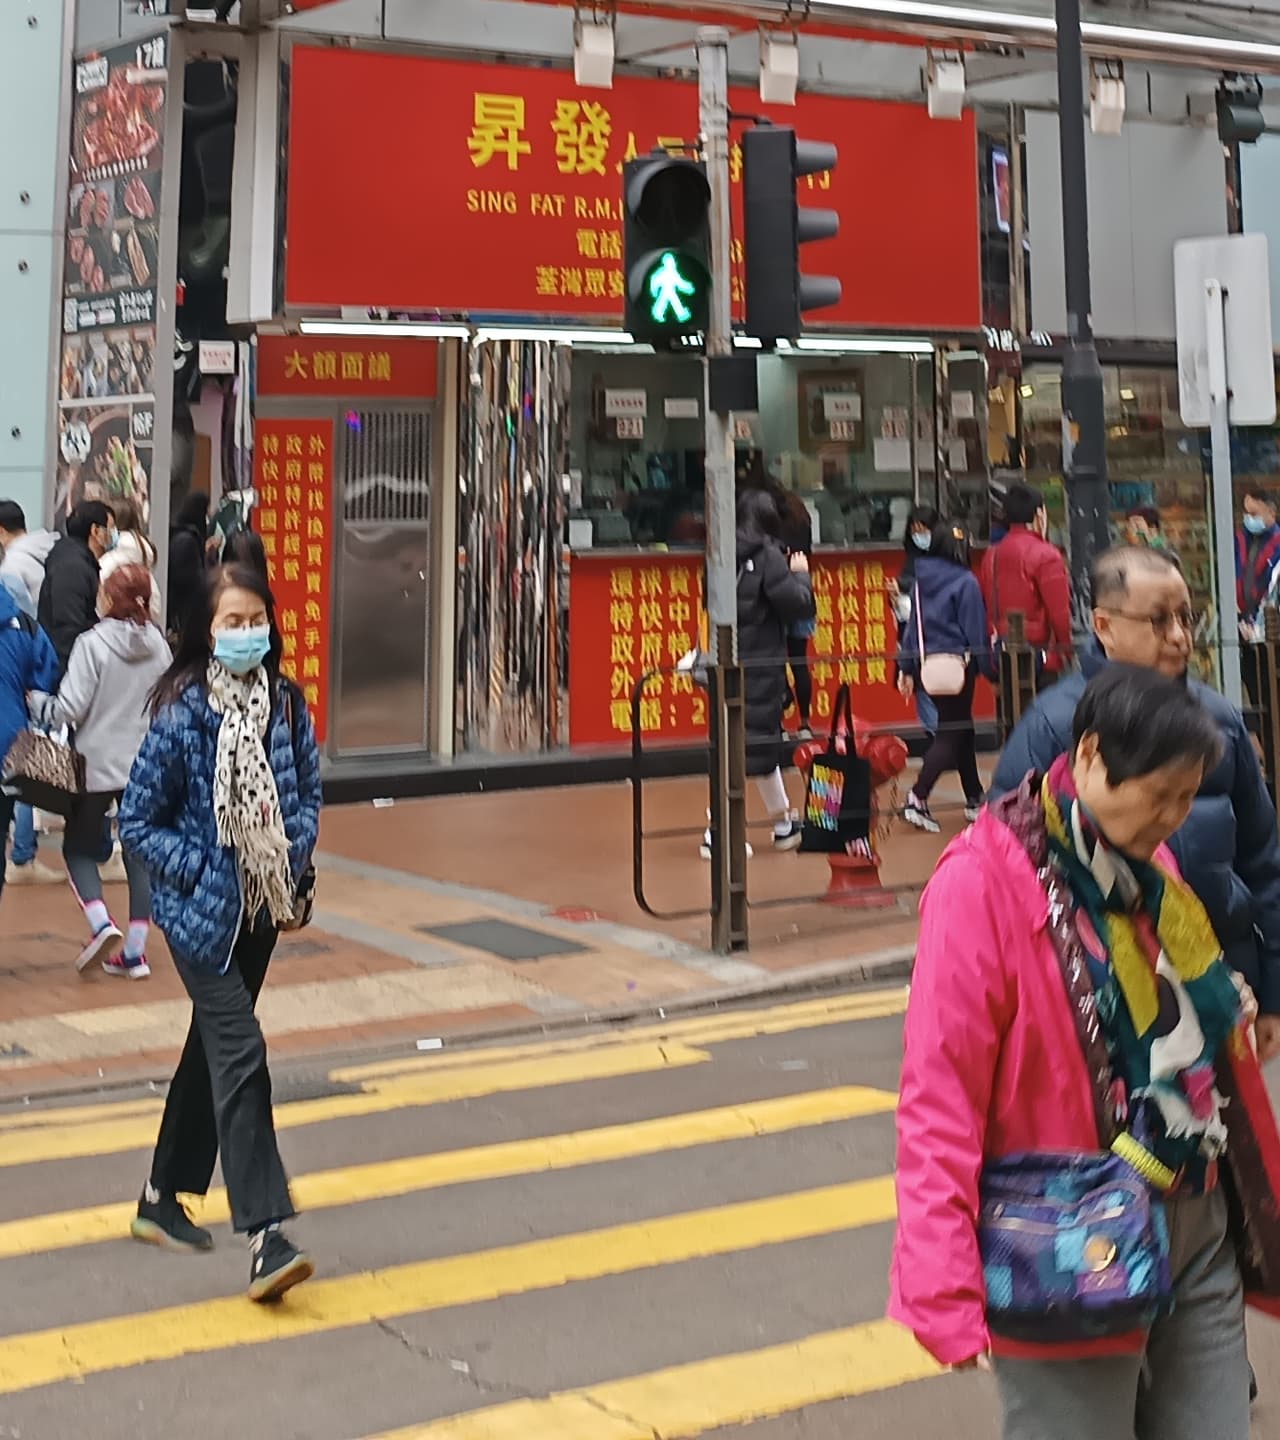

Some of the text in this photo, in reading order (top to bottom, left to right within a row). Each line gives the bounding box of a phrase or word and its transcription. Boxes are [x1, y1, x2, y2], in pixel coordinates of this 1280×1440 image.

[466, 189, 624, 221] SING FAT R.M.
